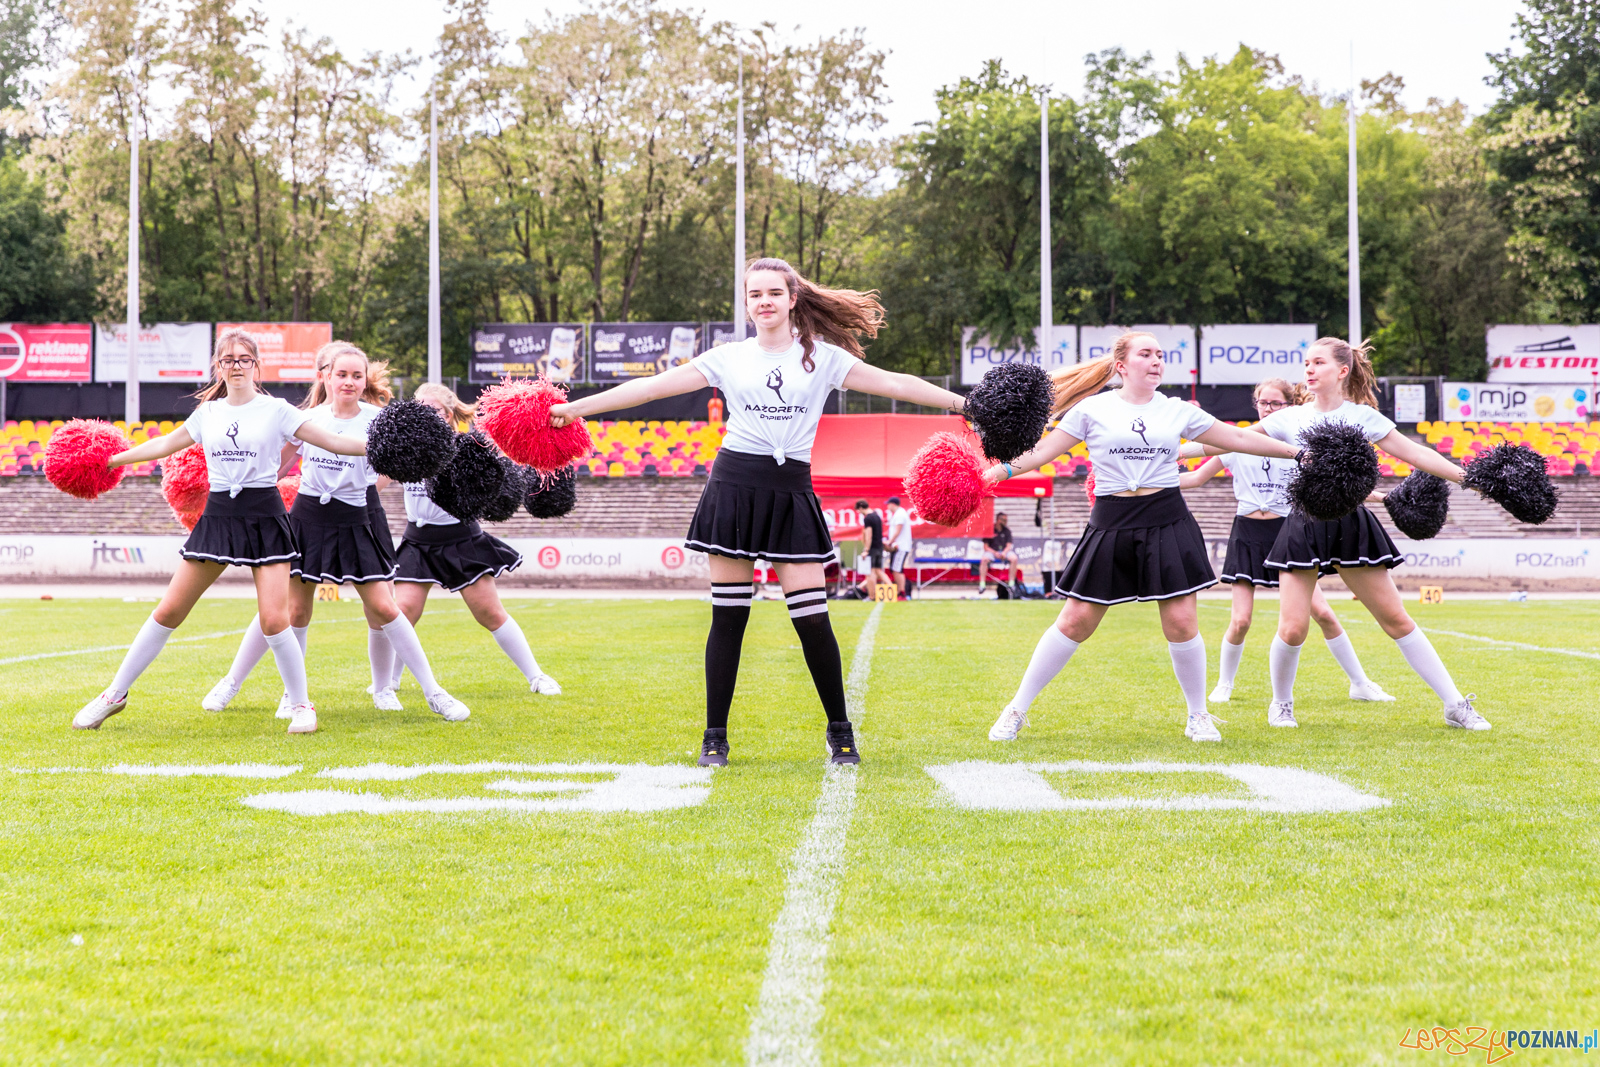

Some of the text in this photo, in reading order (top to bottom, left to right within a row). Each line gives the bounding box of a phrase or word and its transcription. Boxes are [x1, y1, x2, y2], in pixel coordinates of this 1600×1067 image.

[28, 341, 89, 355] reklama
[508, 336, 534, 348] DAJE
[628, 335, 654, 348] DAJE
[1479, 386, 1527, 410] mjp
[1109, 446, 1171, 455] MAŻORETKI
[0, 545, 34, 561] mjp
[566, 553, 622, 567] rodo.pl
[319, 587, 334, 601] 20
[878, 587, 893, 601] 30
[1424, 590, 1440, 603] 40
